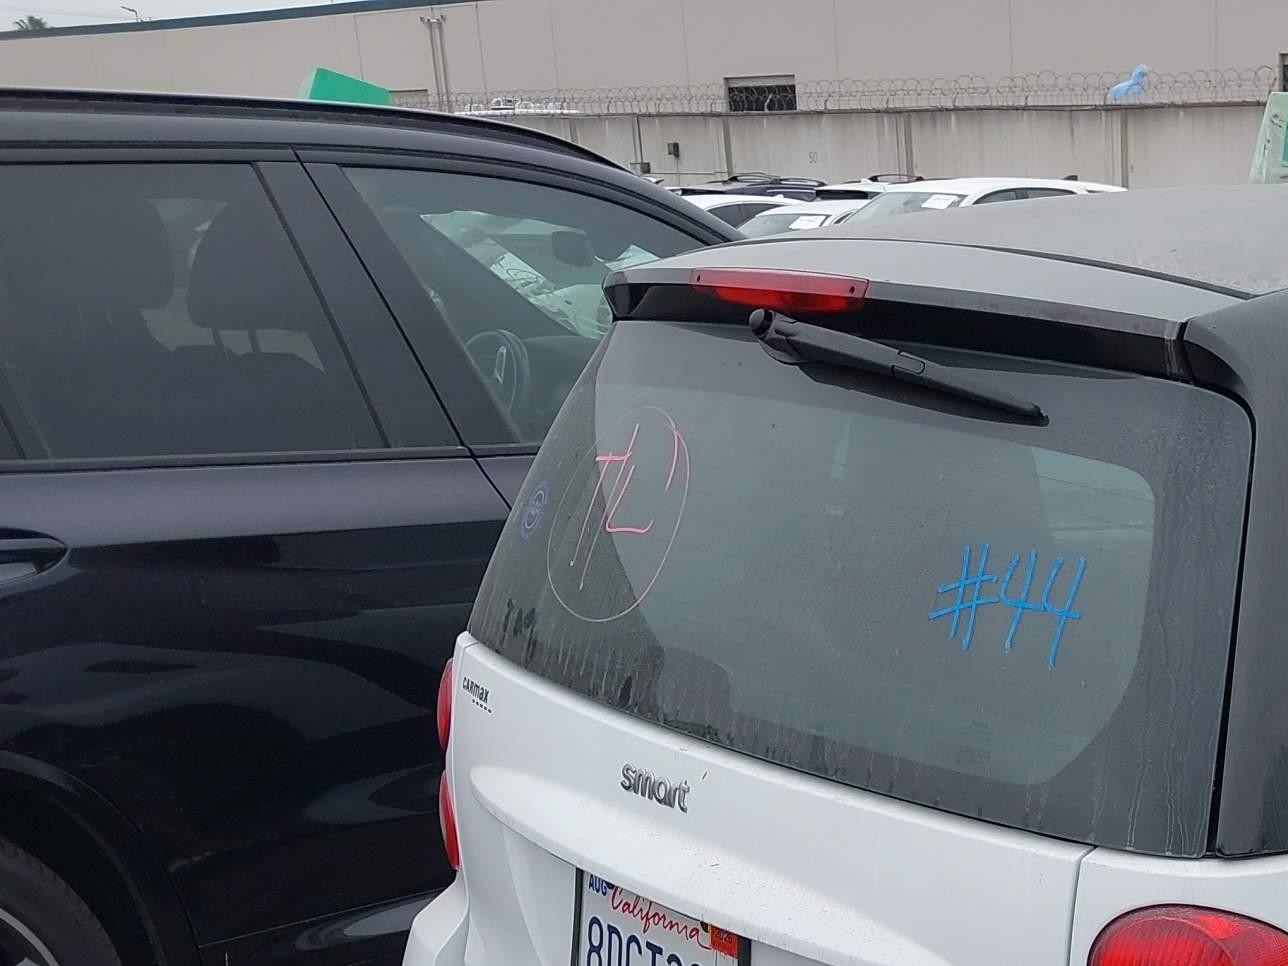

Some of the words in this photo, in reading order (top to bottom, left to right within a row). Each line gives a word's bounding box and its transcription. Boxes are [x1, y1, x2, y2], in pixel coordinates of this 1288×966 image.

[928, 543, 1087, 672] #44
[620, 763, 690, 814] smart
[588, 874, 608, 897] AUG
[609, 886, 712, 951] California
